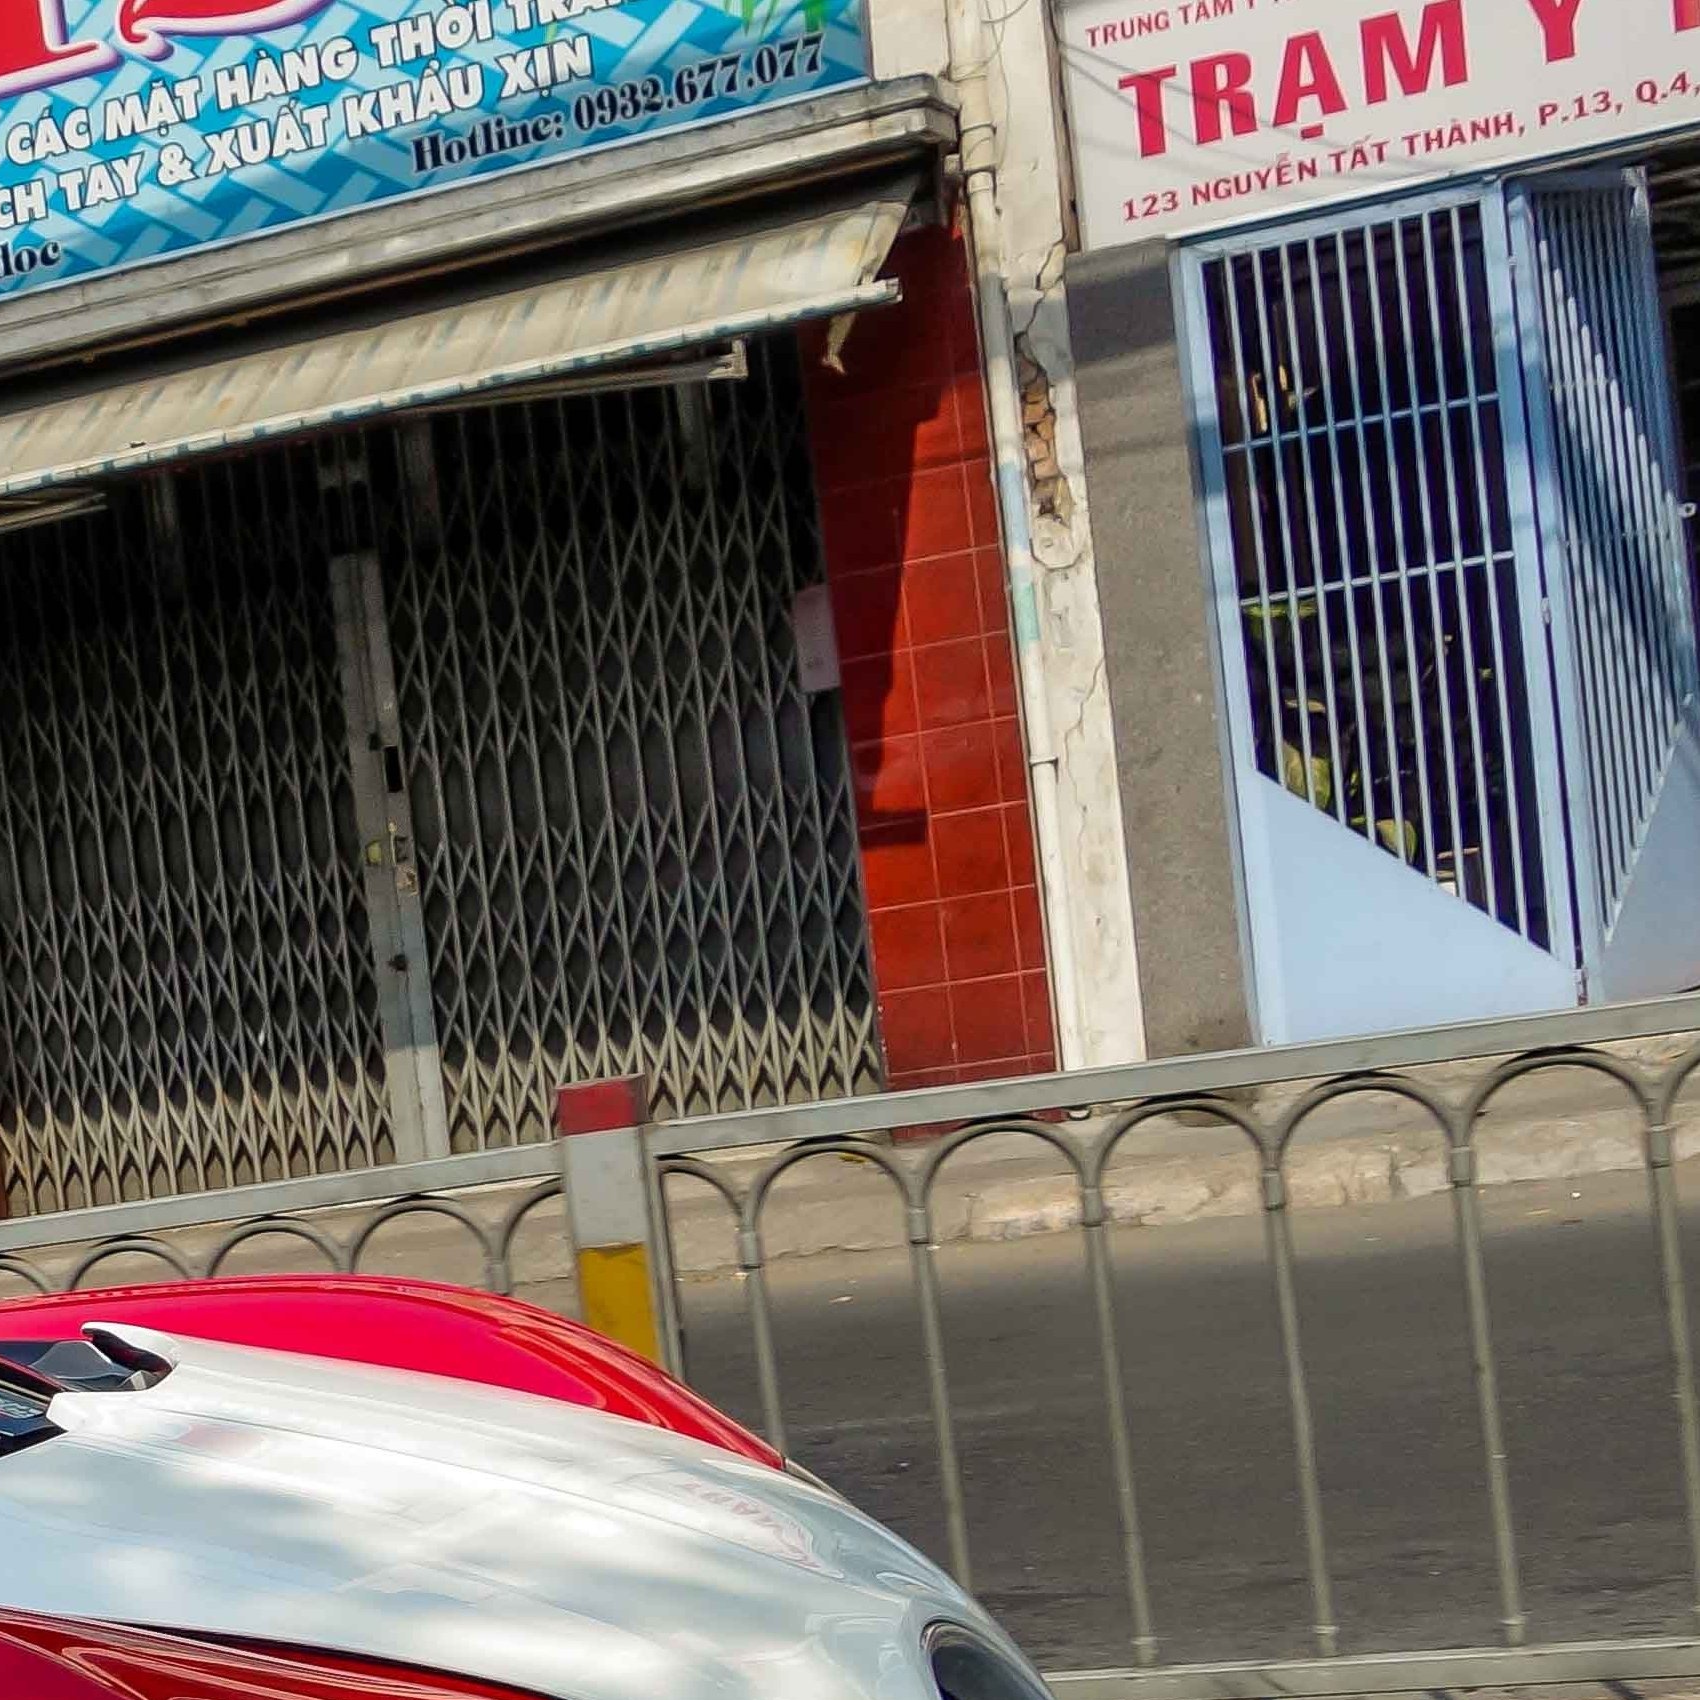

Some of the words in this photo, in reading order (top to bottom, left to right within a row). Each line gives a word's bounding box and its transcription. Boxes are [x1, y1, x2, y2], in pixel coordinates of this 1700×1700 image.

[1085, 11, 1170, 48] TRUNG
[1118, 0, 1468, 158] TRẠM
[1527, 0, 1581, 63] Y
[5, 104, 91, 165] CÁC
[105, 76, 202, 142] MẶT
[217, 36, 358, 110] HÀNG
[57, 152, 144, 211] TAY
[158, 142, 197, 187] &
[203, 97, 331, 177] XUẤT
[343, 60, 485, 140] KHẨU
[500, 35, 593, 98] XỊN
[411, 113, 564, 173] Hotline:
[574, 34, 825, 133] 0932.677.077
[1123, 191, 1179, 222] 123
[1191, 152, 1318, 206] NGUYỄN
[1328, 135, 1390, 173] TẤT
